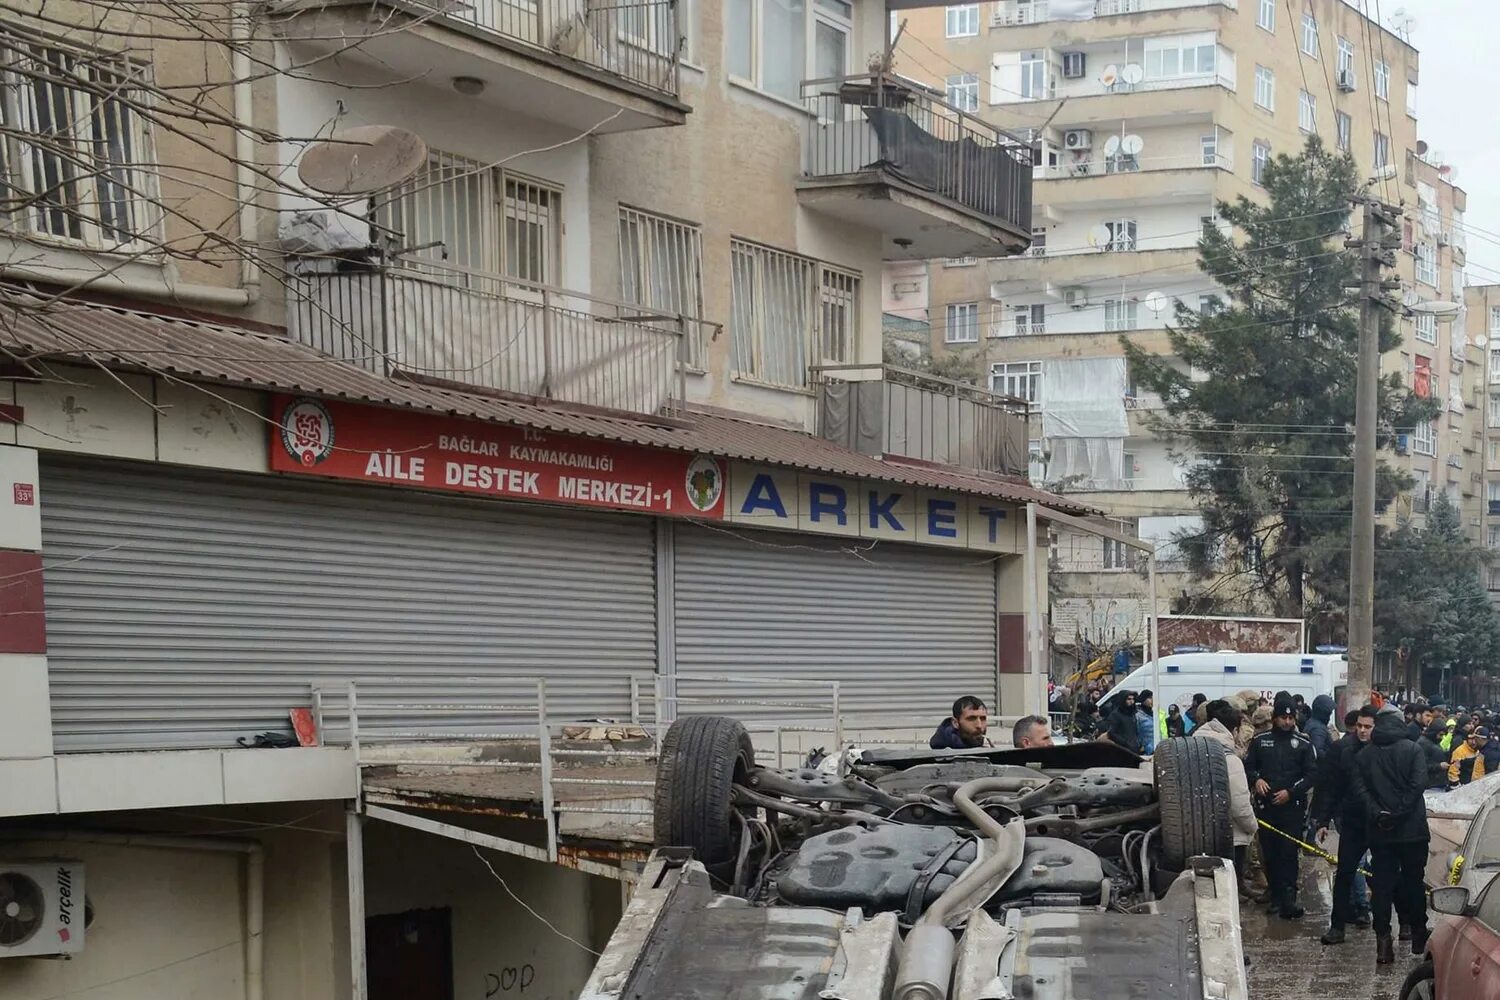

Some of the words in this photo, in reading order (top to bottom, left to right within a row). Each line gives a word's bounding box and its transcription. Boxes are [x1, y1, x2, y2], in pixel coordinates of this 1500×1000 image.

[365, 448, 425, 481] AİLE
[445, 462, 539, 495] DESTEK
[438, 435, 499, 457] BAĞLAR
[510, 445, 613, 472] KAYMAKAMLIĞI
[741, 474, 1007, 543] ARKET
[57, 867, 73, 925] arçelik
